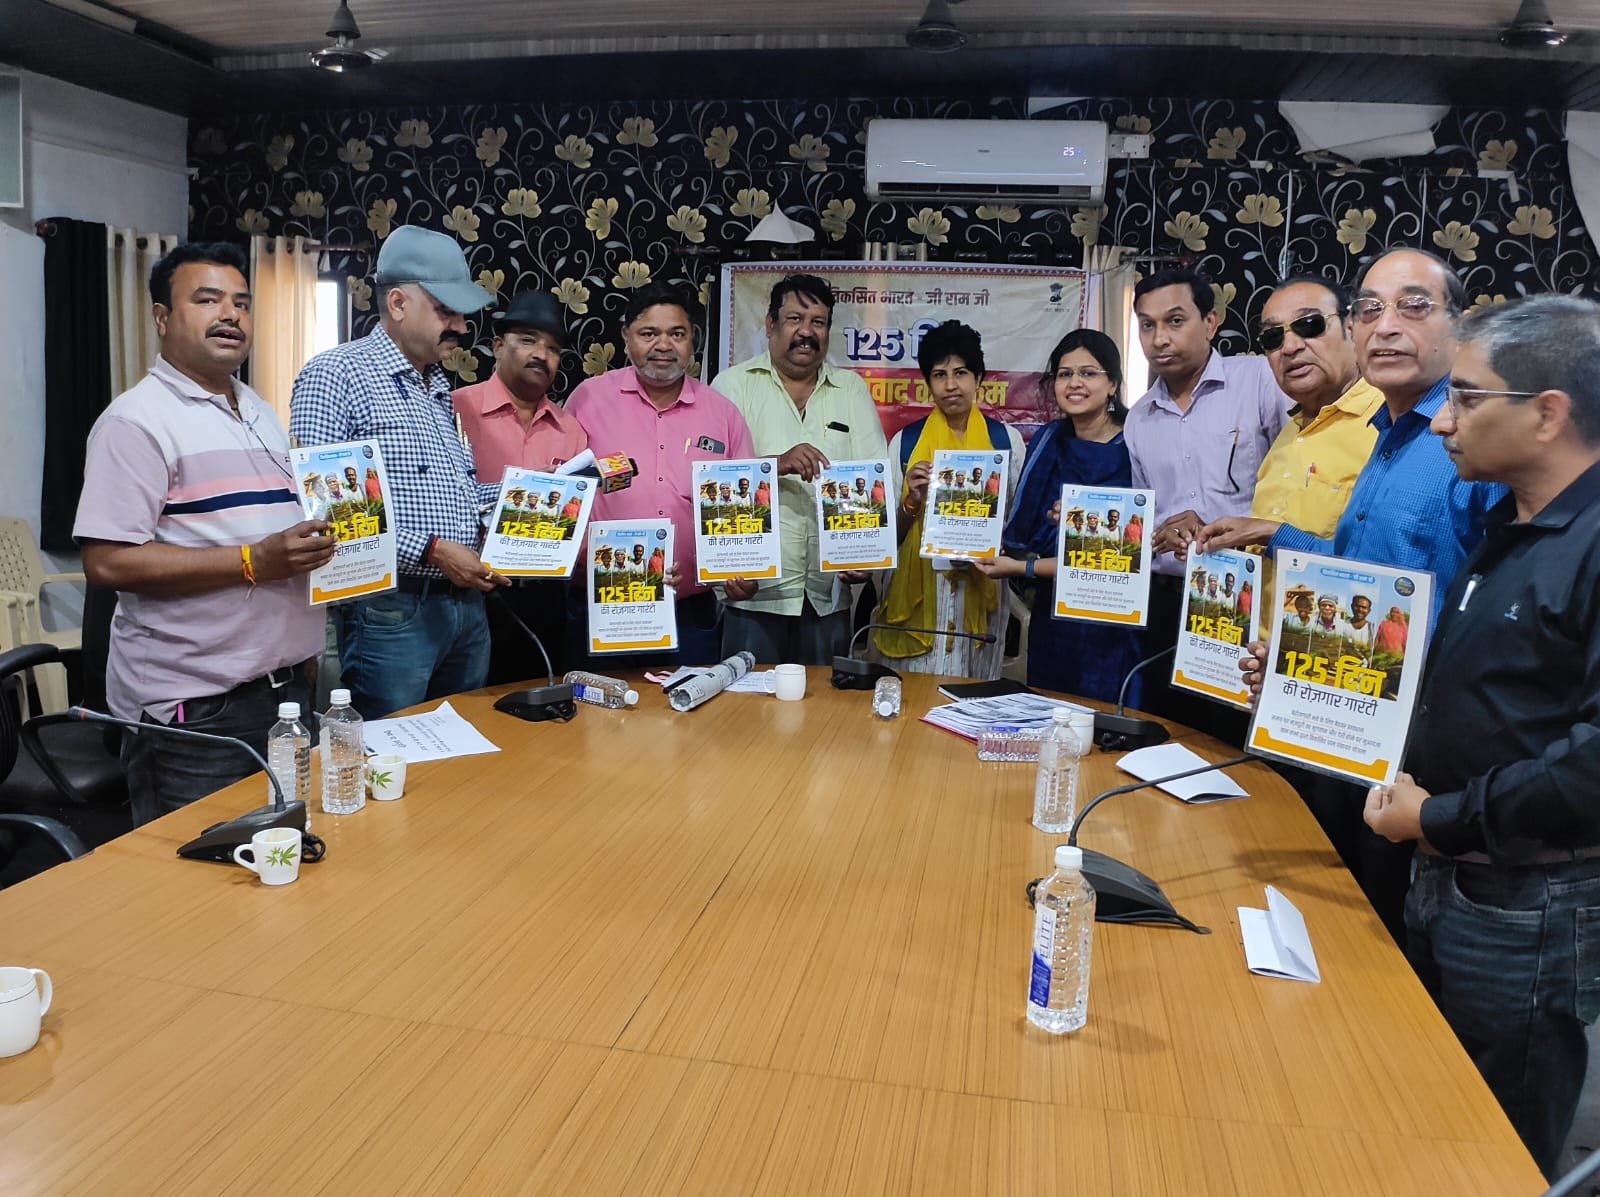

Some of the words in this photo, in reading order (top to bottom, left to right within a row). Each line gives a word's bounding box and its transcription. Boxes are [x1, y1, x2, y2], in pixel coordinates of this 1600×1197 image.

[1063, 146, 1075, 157] 25
[880, 290, 914, 305] भारत
[925, 288, 944, 306] जी
[945, 291, 970, 306] राम
[973, 289, 990, 307] जी
[843, 327, 905, 361] 125
[938, 501, 962, 517] 125
[964, 499, 991, 518] दिन
[351, 512, 380, 538] दिन
[502, 520, 531, 537] 125
[533, 521, 567, 541] दिन
[706, 518, 732, 535] 125
[736, 513, 764, 534] दिन
[827, 514, 851, 531] 125
[854, 512, 880, 529] दिन
[1068, 549, 1097, 570] 125
[1100, 548, 1133, 574] दिन
[598, 586, 625, 604] 125
[628, 581, 656, 602] दिन
[1190, 614, 1215, 639] 125
[1216, 616, 1243, 647] दिन
[1285, 651, 1329, 685] 125
[1334, 654, 1387, 698] दिन
[1283, 679, 1298, 697] की
[1344, 697, 1378, 717] गारंटी
[1039, 915, 1052, 959] ELITE
